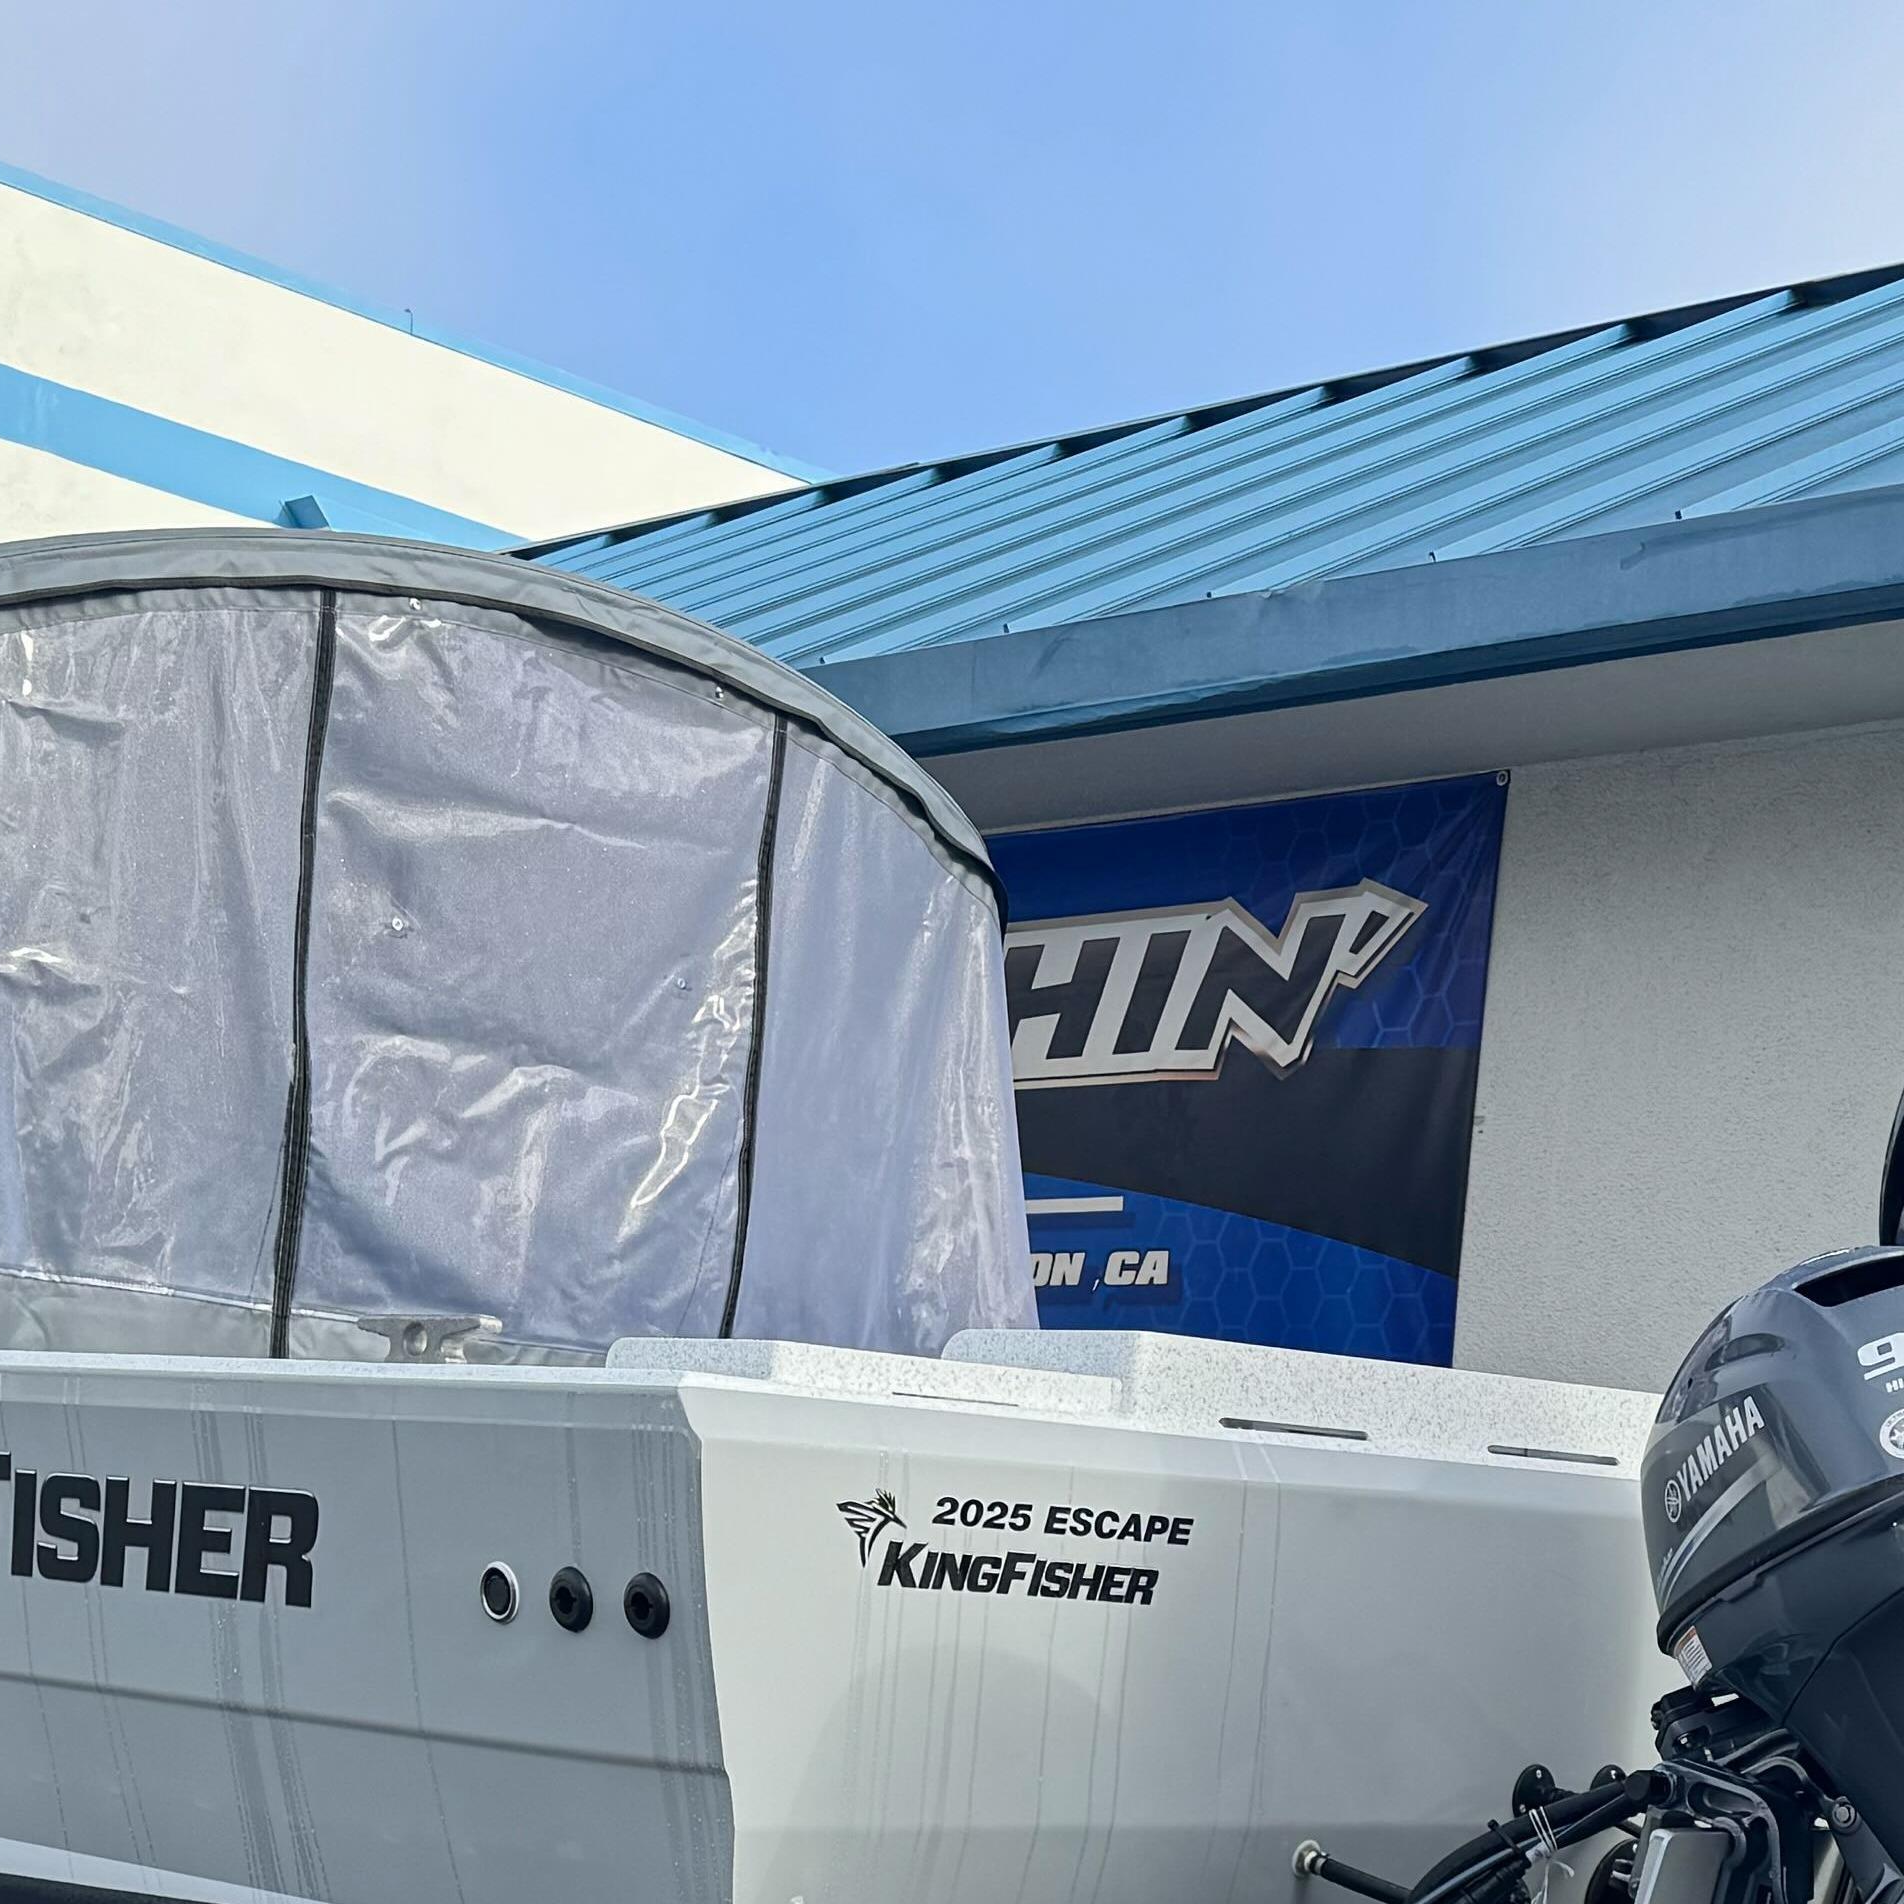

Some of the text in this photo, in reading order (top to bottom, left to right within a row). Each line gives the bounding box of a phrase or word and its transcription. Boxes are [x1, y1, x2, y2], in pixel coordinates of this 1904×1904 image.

[1004, 886, 1422, 1074] HIN'
[1029, 1250, 1085, 1286] ON
[1675, 1395, 1766, 1502] YAMAHA
[931, 1495, 1195, 1546] 2025 ESCAPE
